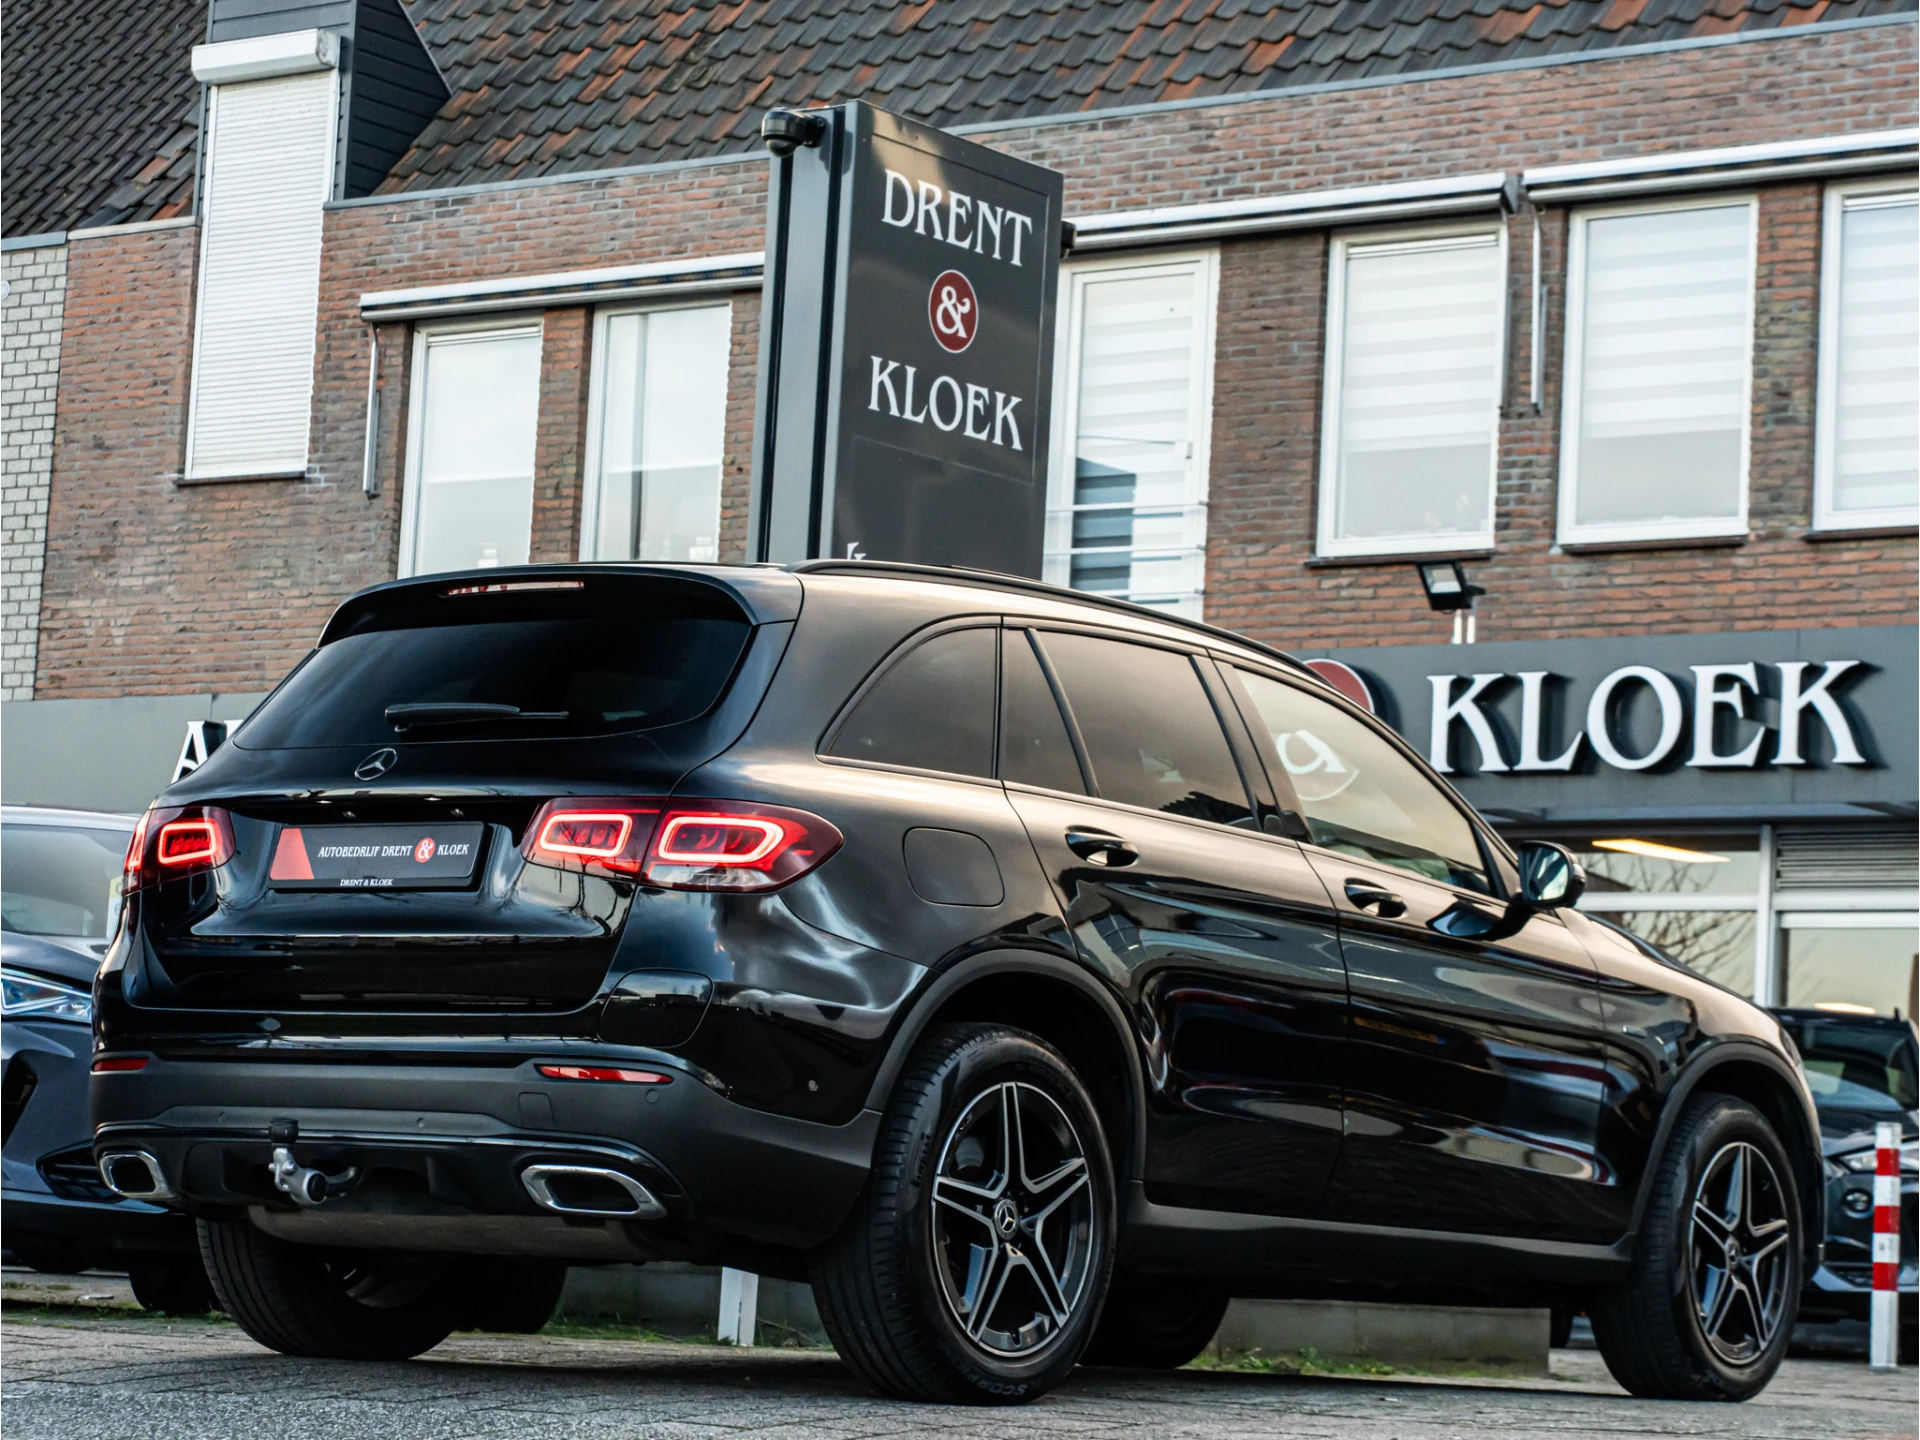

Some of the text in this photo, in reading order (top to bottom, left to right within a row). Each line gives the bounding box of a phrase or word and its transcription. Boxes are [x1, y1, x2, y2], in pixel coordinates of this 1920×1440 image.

[881, 169, 1033, 267] DRENT
[935, 285, 971, 339] &
[868, 355, 1023, 451] KLOEK
[1427, 660, 1867, 773] KLOEK
[318, 840, 469, 860] AUTOBEDRIJF DRENT & KLOEK
[340, 878, 363, 886] DRENT
[370, 878, 393, 886] KLOEK
